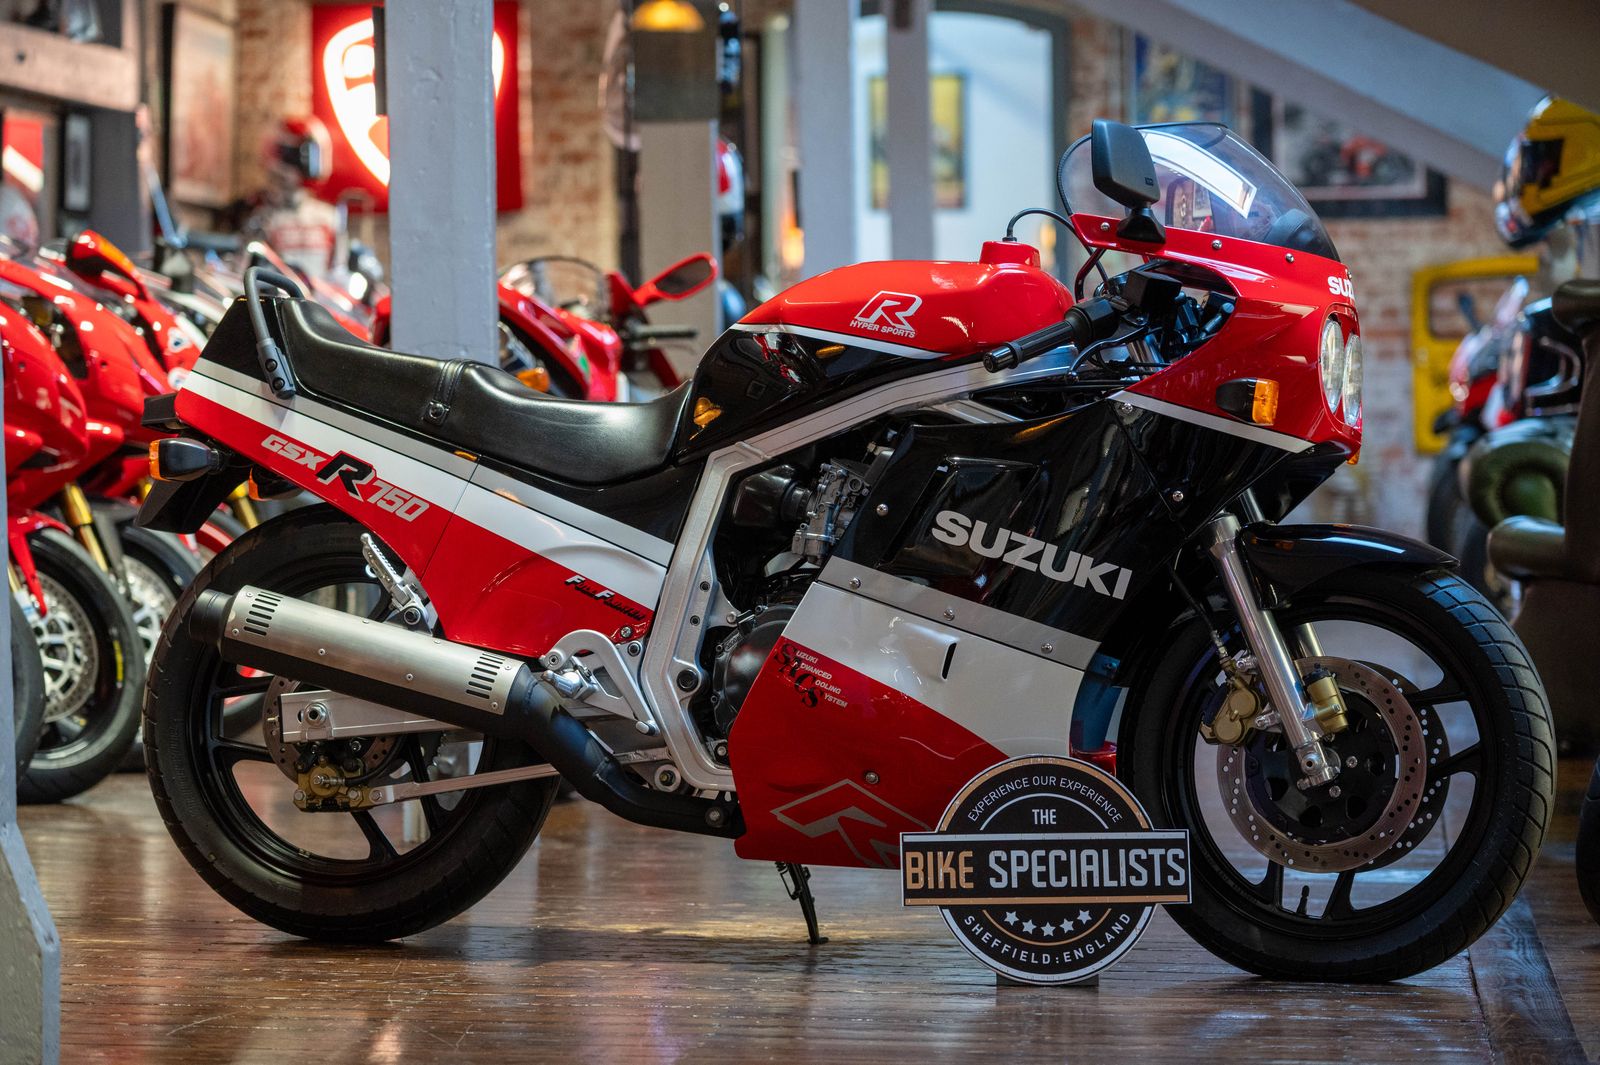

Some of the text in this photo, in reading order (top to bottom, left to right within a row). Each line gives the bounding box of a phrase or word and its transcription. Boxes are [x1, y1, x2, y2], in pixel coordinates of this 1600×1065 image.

[849, 319, 916, 339] HYPER SPORTS
[931, 510, 1133, 600] SUZUKI
[967, 776, 1123, 823] EXPERIENCE OUR EXPERIENCE
[1032, 809, 1057, 825] THE
[905, 851, 974, 890] BIKE
[988, 848, 1186, 889] SPECIALISTS
